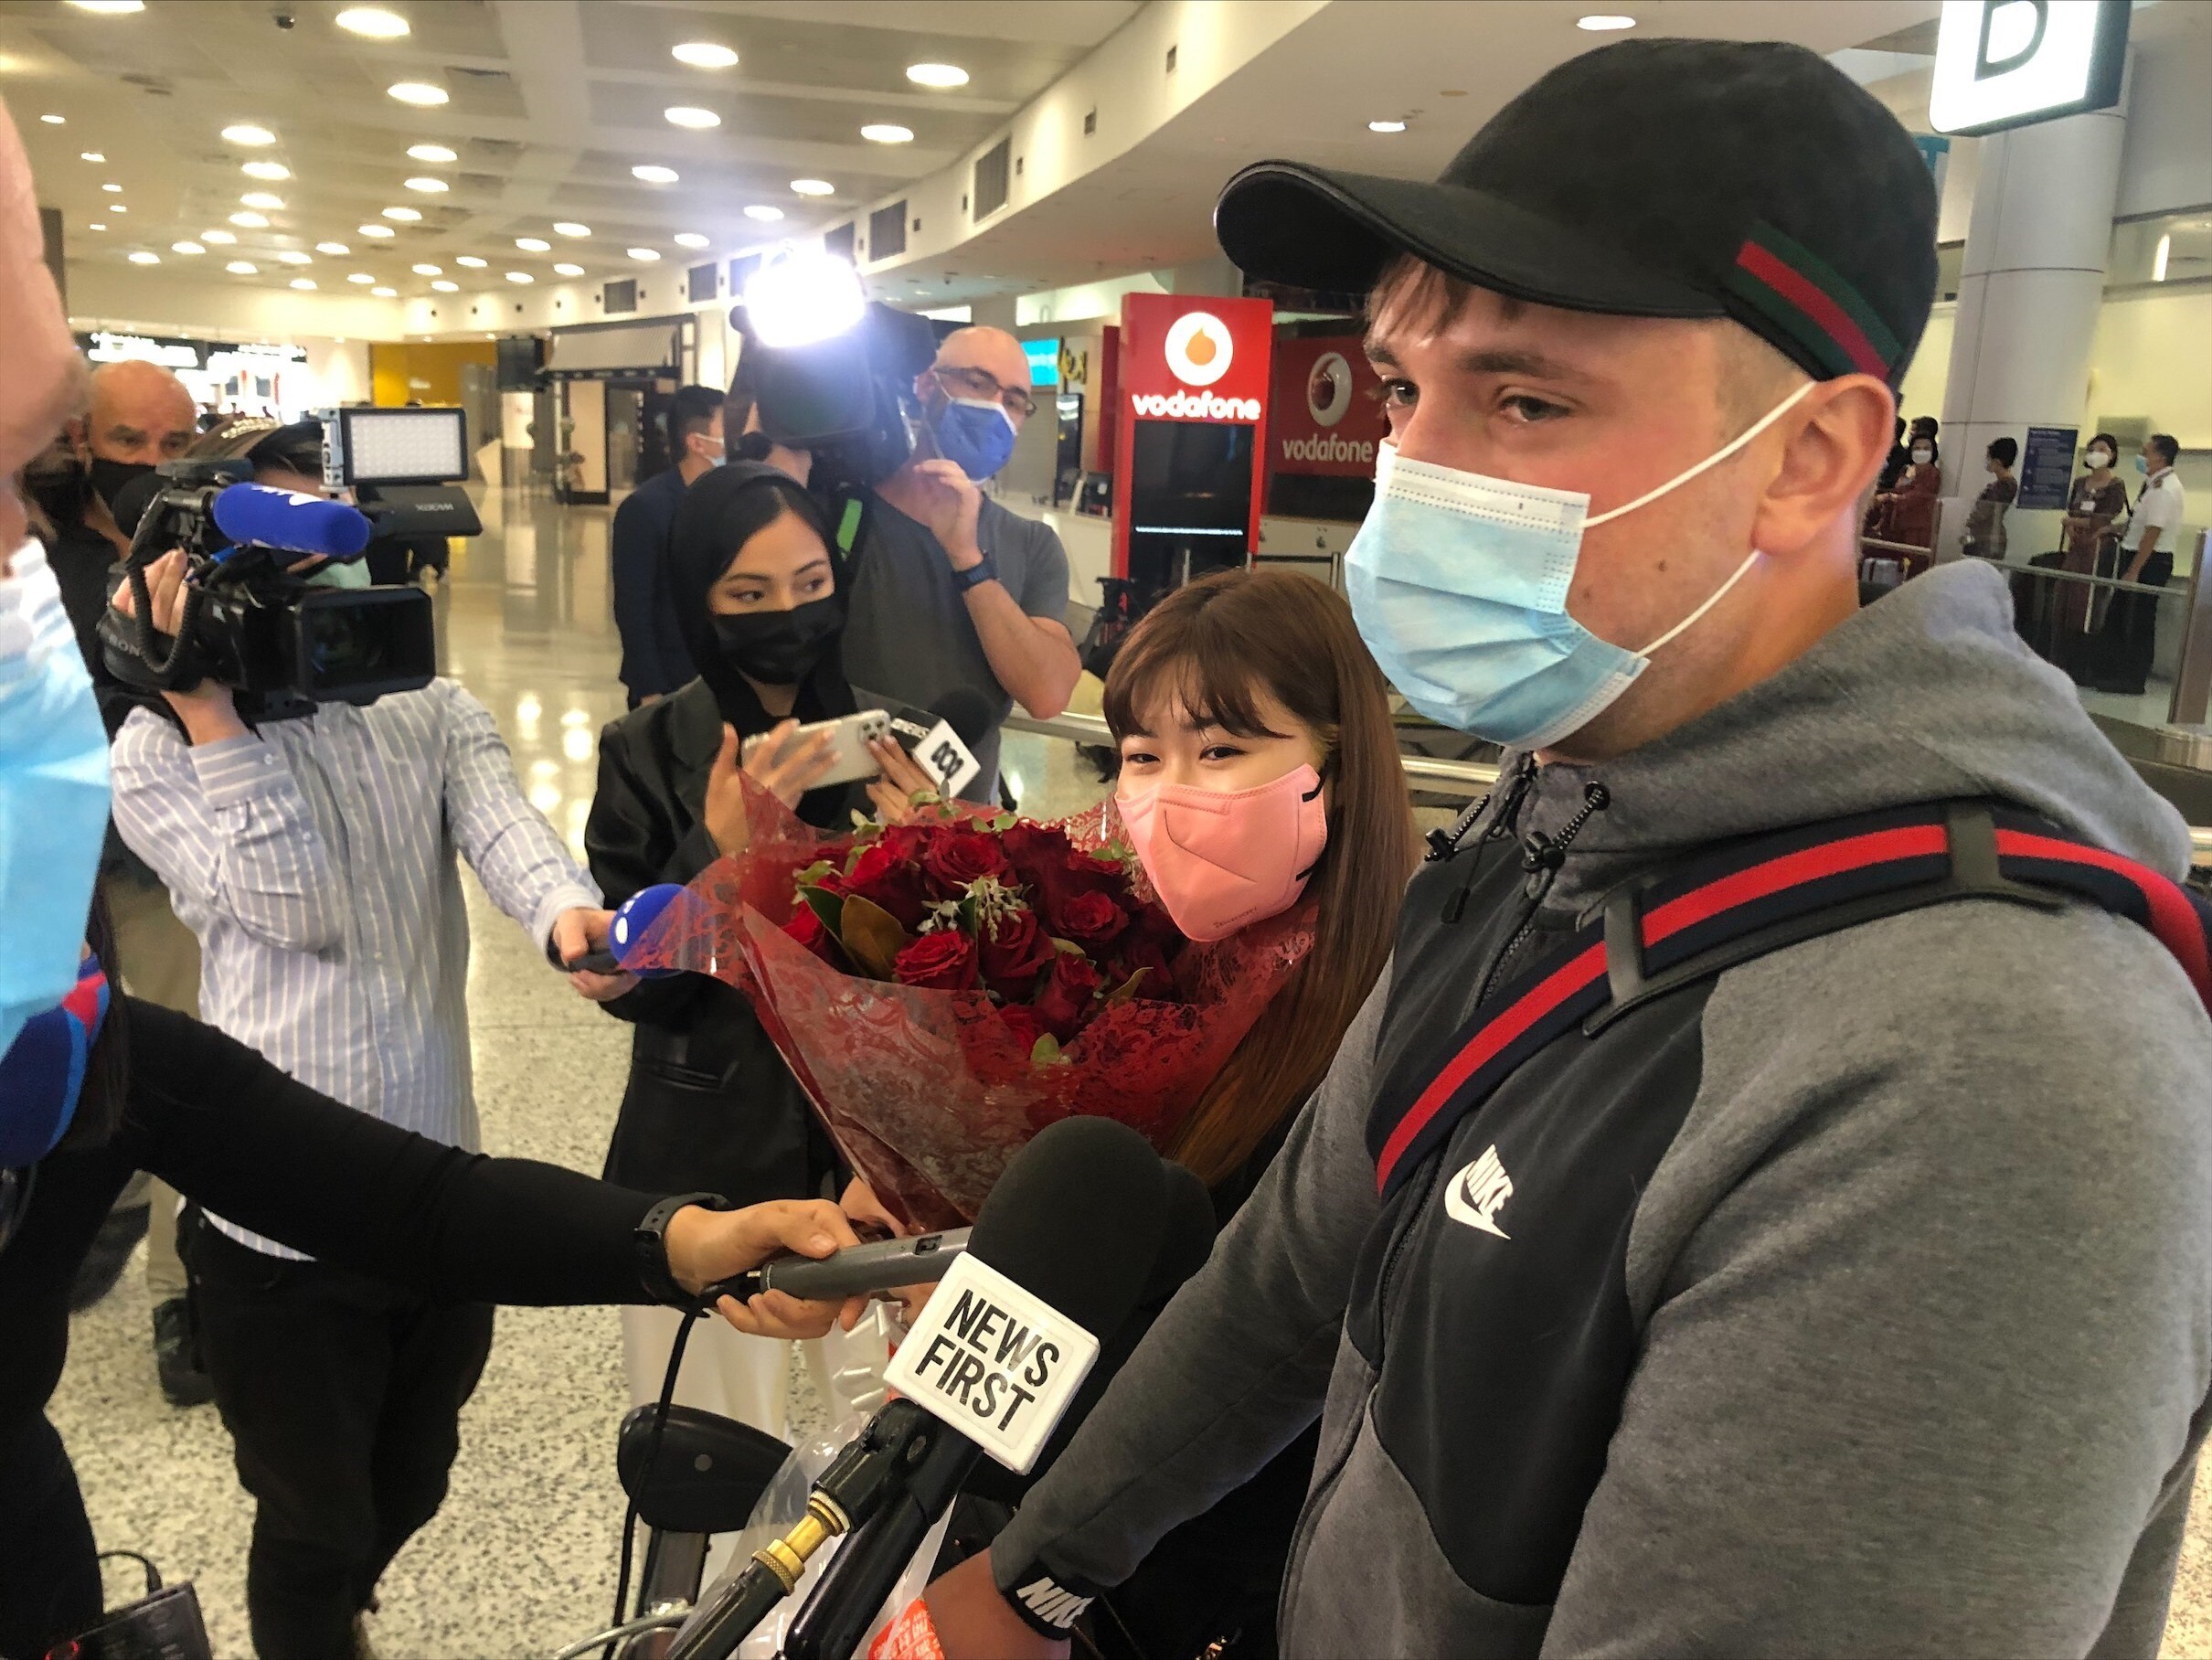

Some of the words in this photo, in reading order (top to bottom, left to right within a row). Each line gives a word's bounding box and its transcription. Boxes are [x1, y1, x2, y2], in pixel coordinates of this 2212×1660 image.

[1132, 388, 1261, 420] vodafone
[1282, 432, 1373, 463] vodafone
[943, 1289, 1059, 1387] NEWS
[915, 1334, 1036, 1431] FIRST
